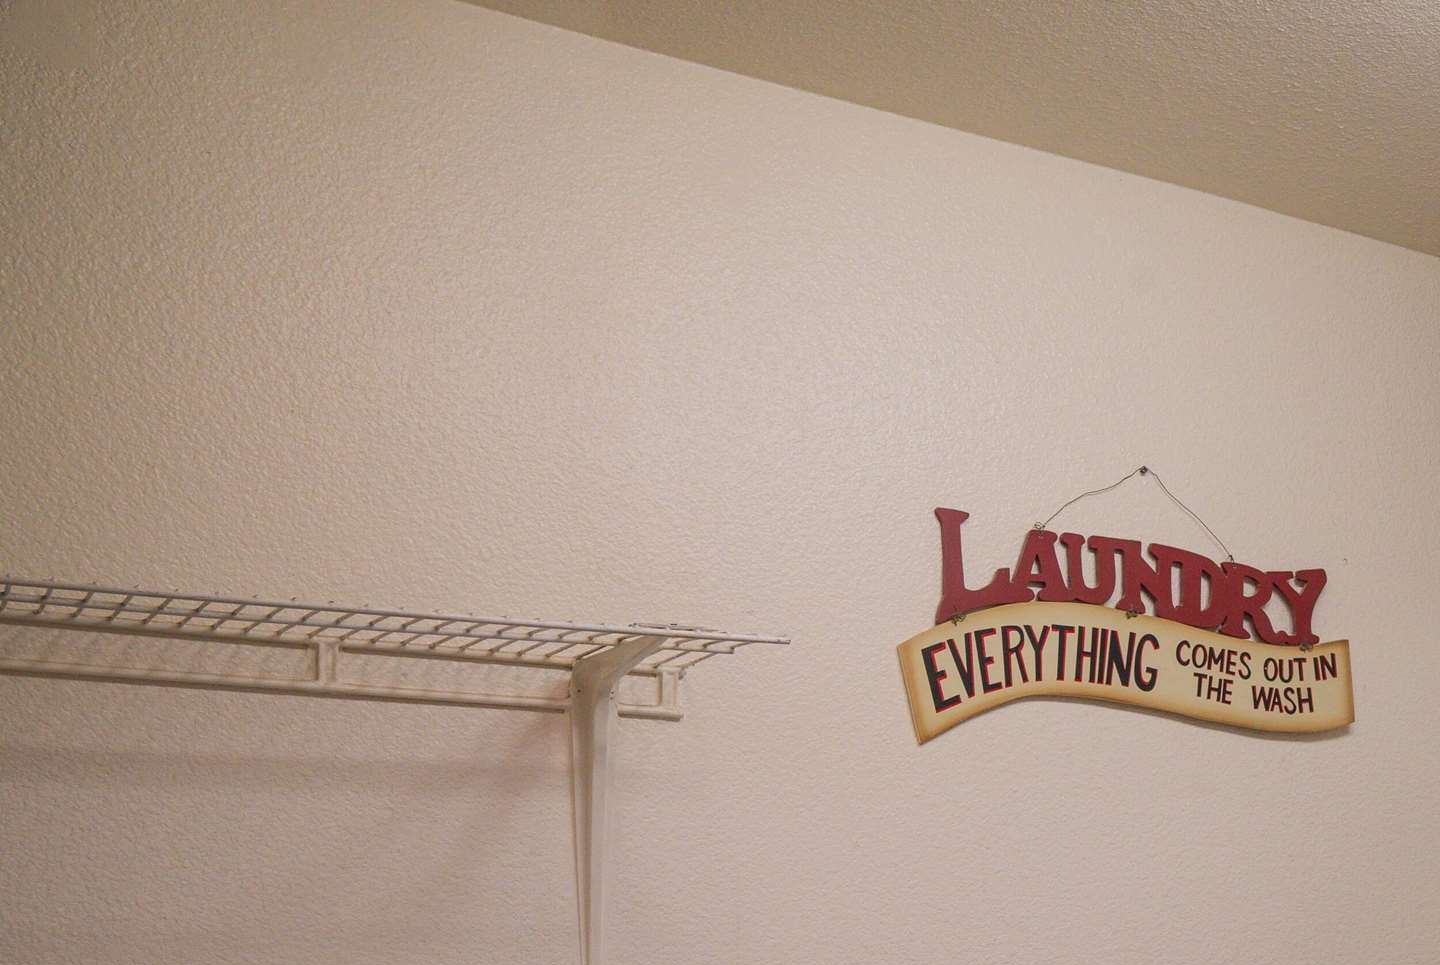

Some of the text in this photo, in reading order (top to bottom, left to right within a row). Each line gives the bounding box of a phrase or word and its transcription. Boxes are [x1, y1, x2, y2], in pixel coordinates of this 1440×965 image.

[934, 507, 1328, 646] LAUNDRY
[921, 624, 1160, 713] EVERYTHING
[1175, 639, 1337, 682] COMES OUT IN
[1194, 672, 1314, 714] THE WASH
